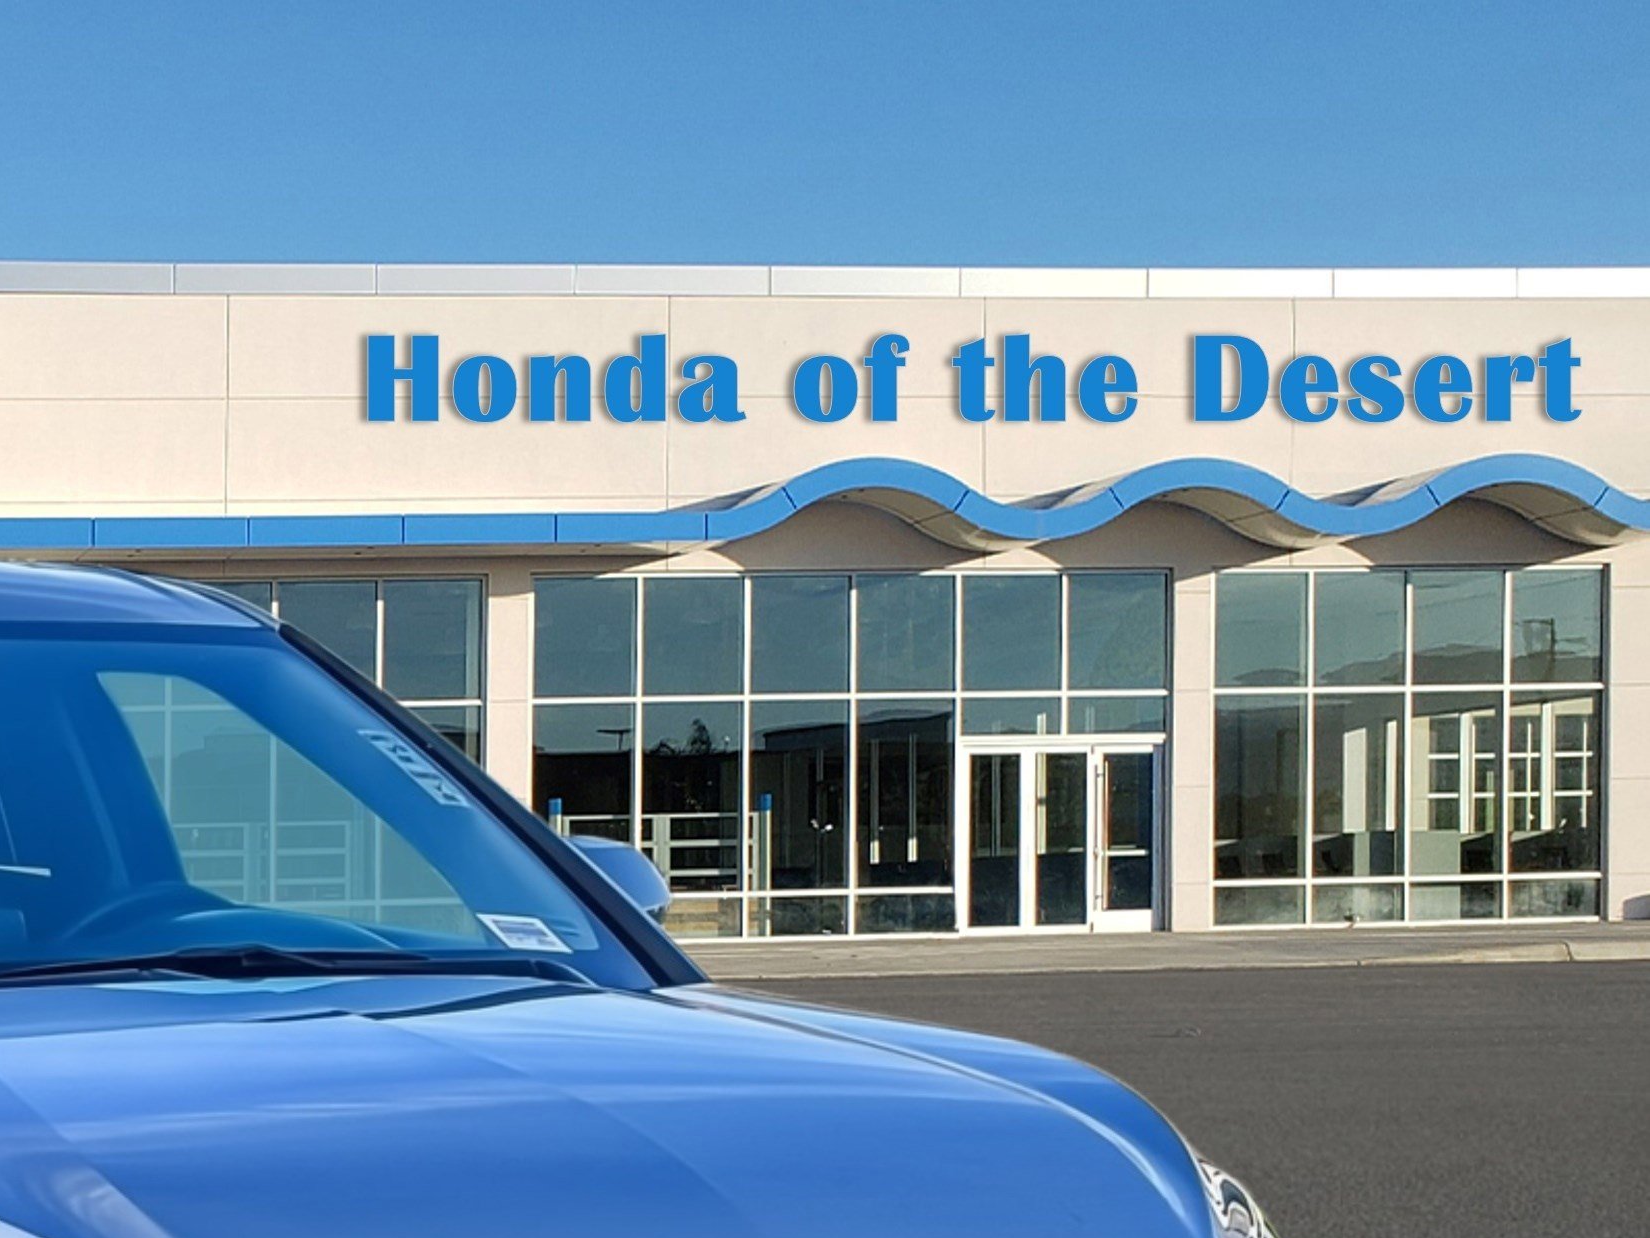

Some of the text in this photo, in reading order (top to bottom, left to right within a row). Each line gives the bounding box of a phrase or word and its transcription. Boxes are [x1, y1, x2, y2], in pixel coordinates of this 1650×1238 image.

[365, 332, 1584, 424] Honda of the Desert
